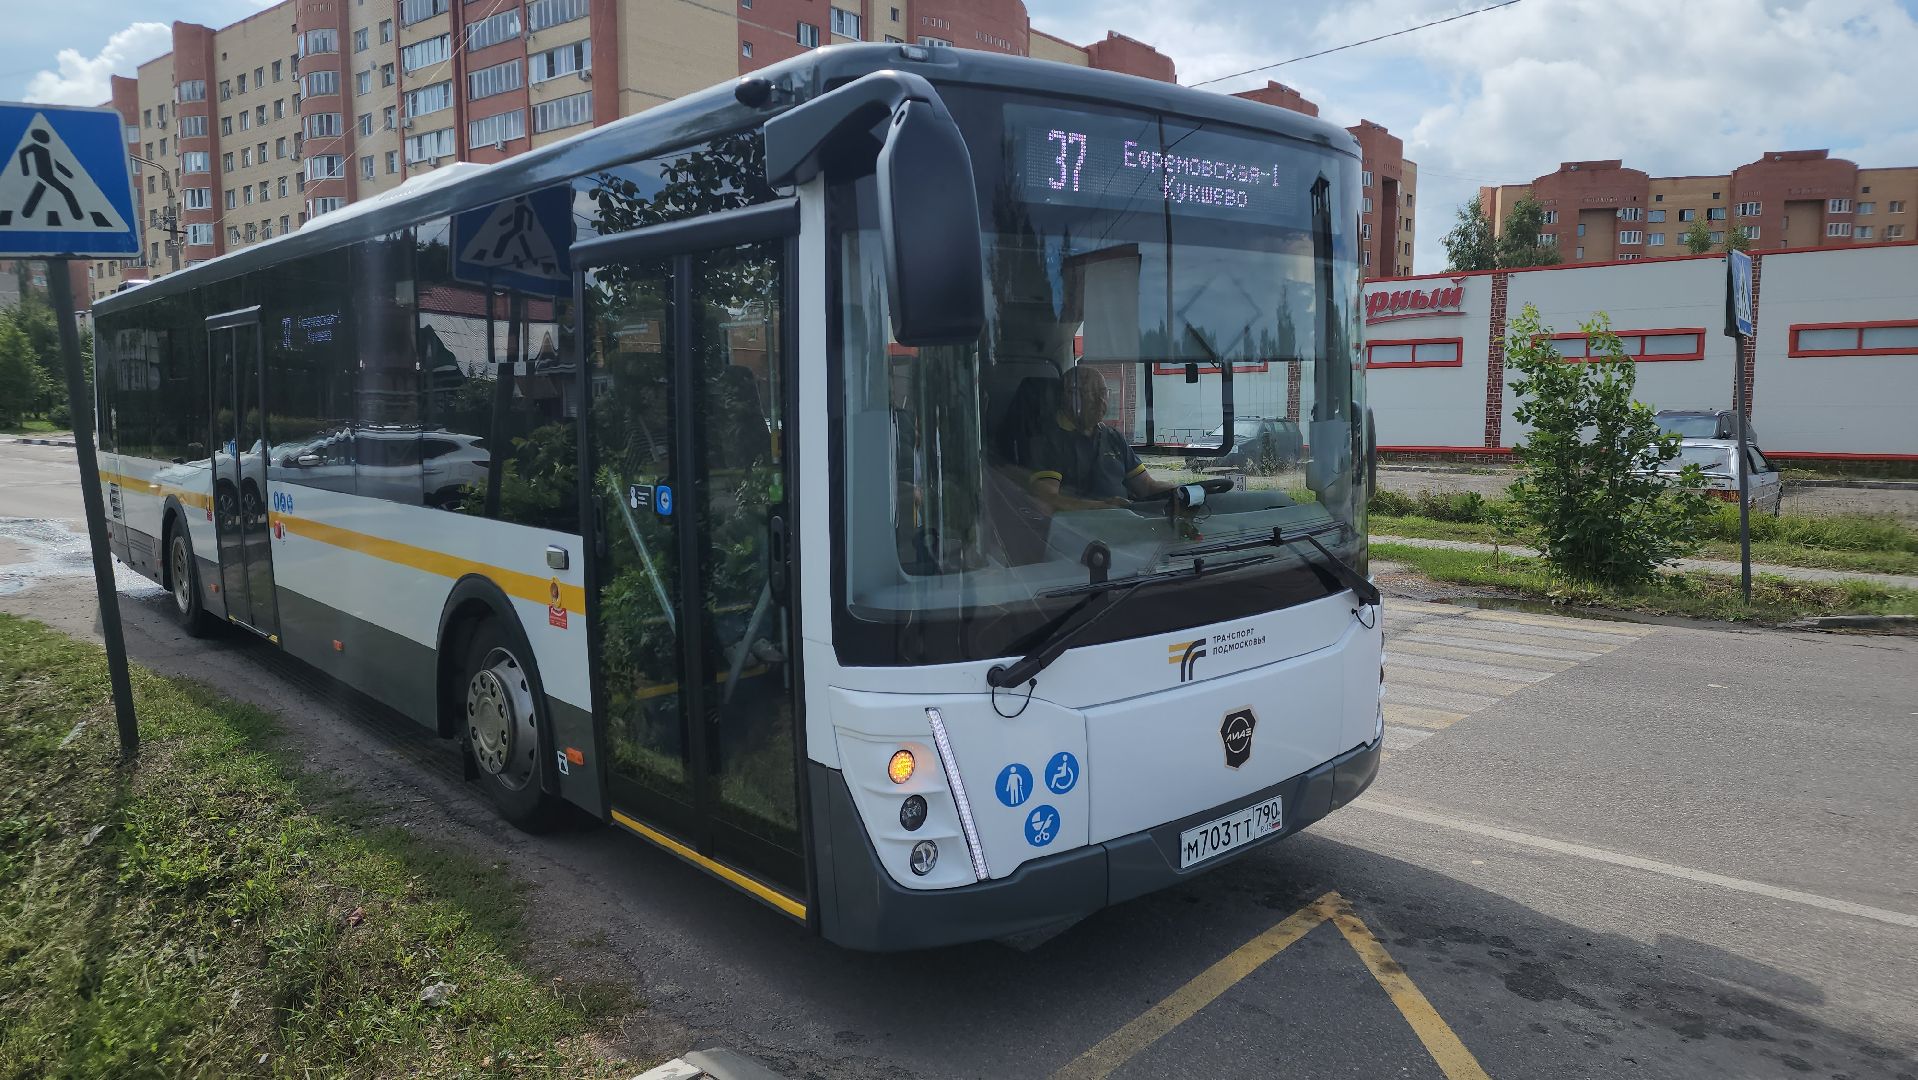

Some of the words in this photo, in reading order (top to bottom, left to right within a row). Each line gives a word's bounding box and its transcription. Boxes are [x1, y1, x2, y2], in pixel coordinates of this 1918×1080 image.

[1048, 129, 1087, 192] 37
[1124, 141, 1280, 187] Ефремовская-1
[1164, 174, 1248, 208] Кукшево
[1365, 276, 1467, 319] рный
[1212, 628, 1254, 644] ТРАНСПОРТ
[1212, 635, 1266, 655] ПОДМОСКОВЬЯ
[1255, 801, 1278, 827] 790
